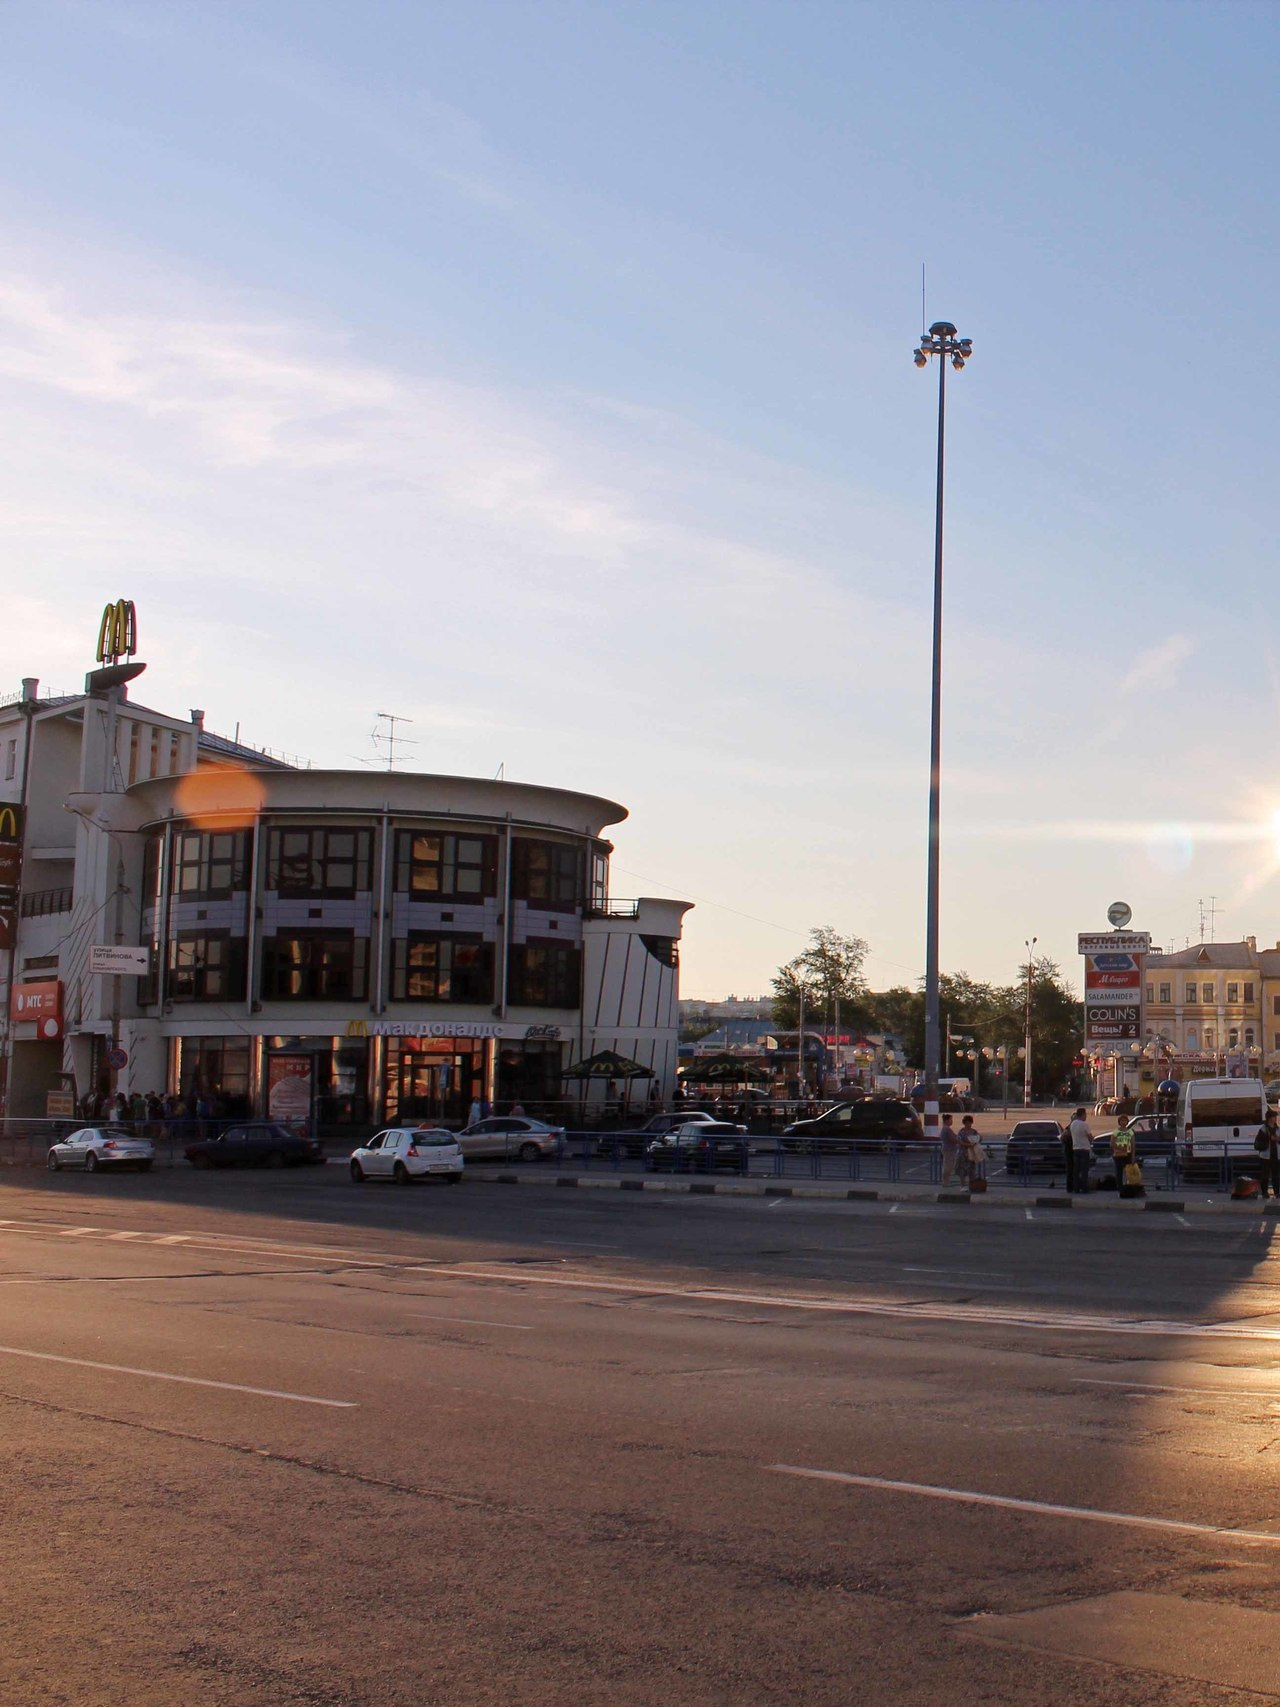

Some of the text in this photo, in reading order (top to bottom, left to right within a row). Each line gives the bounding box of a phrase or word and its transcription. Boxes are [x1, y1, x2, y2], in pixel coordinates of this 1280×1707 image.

[1079, 936, 1147, 945] РЕСПУБЛИКА
[26, 994, 42, 1008] МТС
[1088, 993, 1134, 1001] SALAMANDER
[1089, 1007, 1136, 1022] COLIN'S
[1091, 1024, 1136, 1034] Вещь! 2
